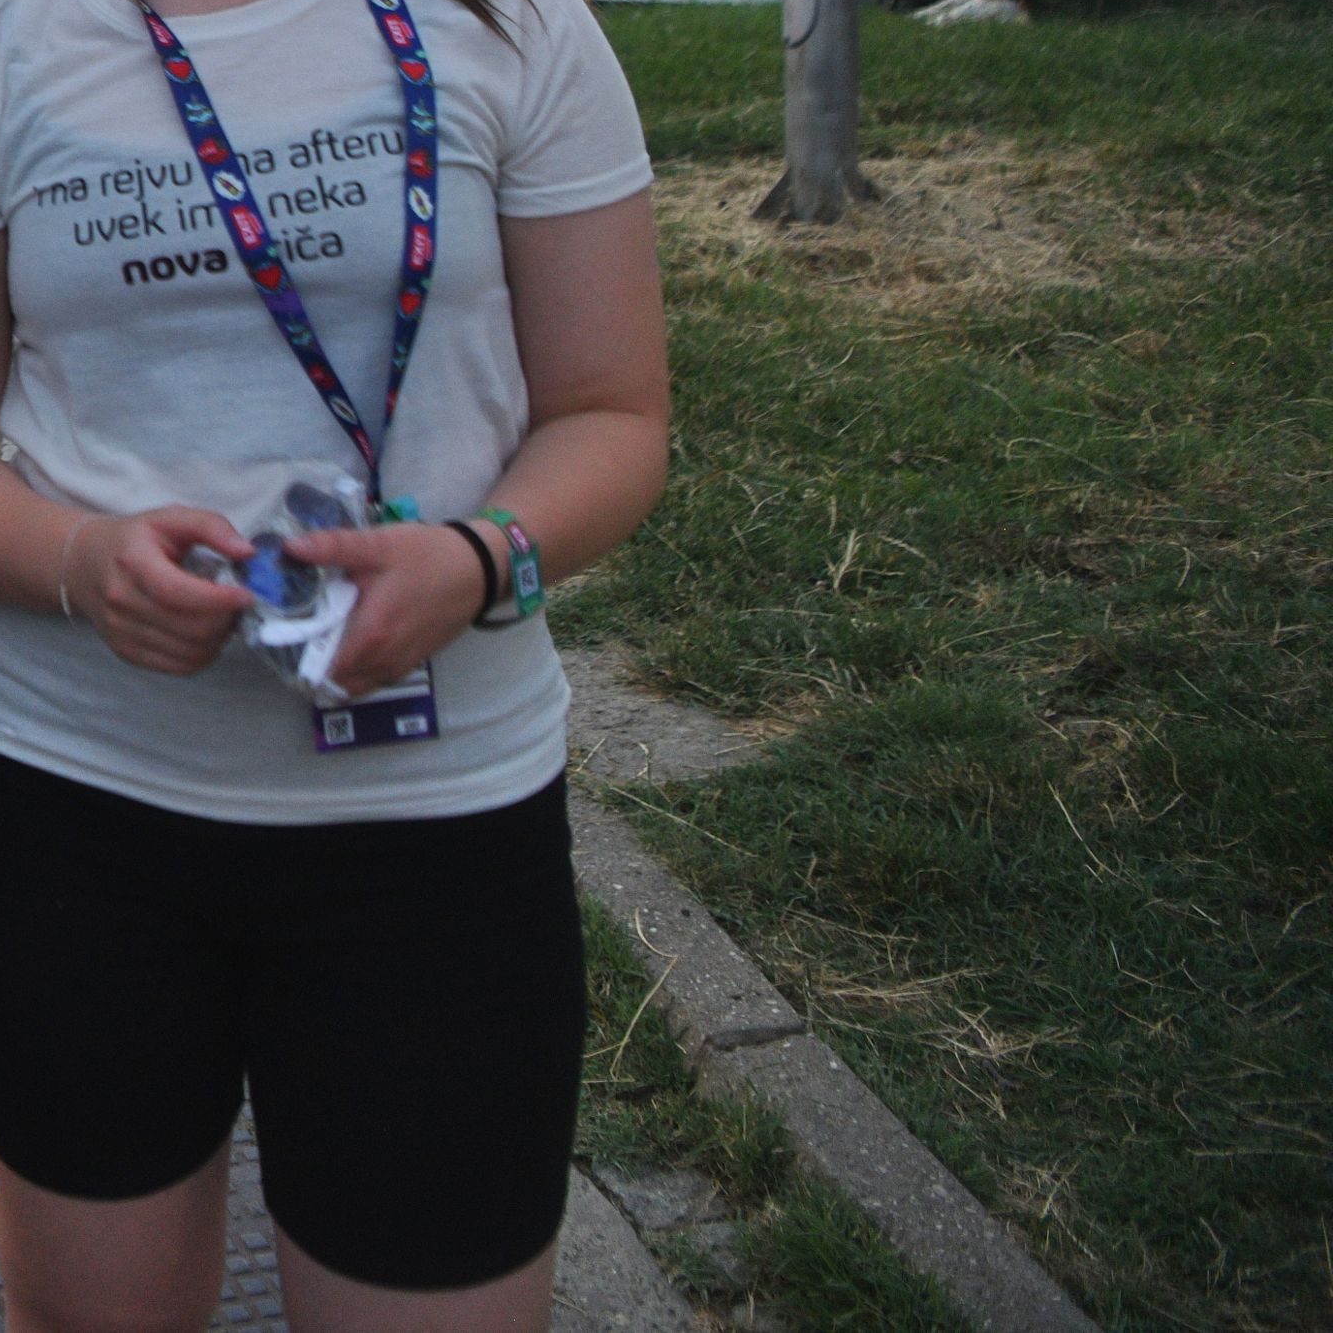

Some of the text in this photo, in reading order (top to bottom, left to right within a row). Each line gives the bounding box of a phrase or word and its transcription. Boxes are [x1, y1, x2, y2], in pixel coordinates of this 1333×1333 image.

[101, 159, 193, 199] rejvu
[289, 128, 406, 169] afteru
[74, 201, 165, 246] uvek
[268, 175, 367, 219] neka
[122, 248, 229, 286] nova
[412, 229, 428, 267] EXIT
